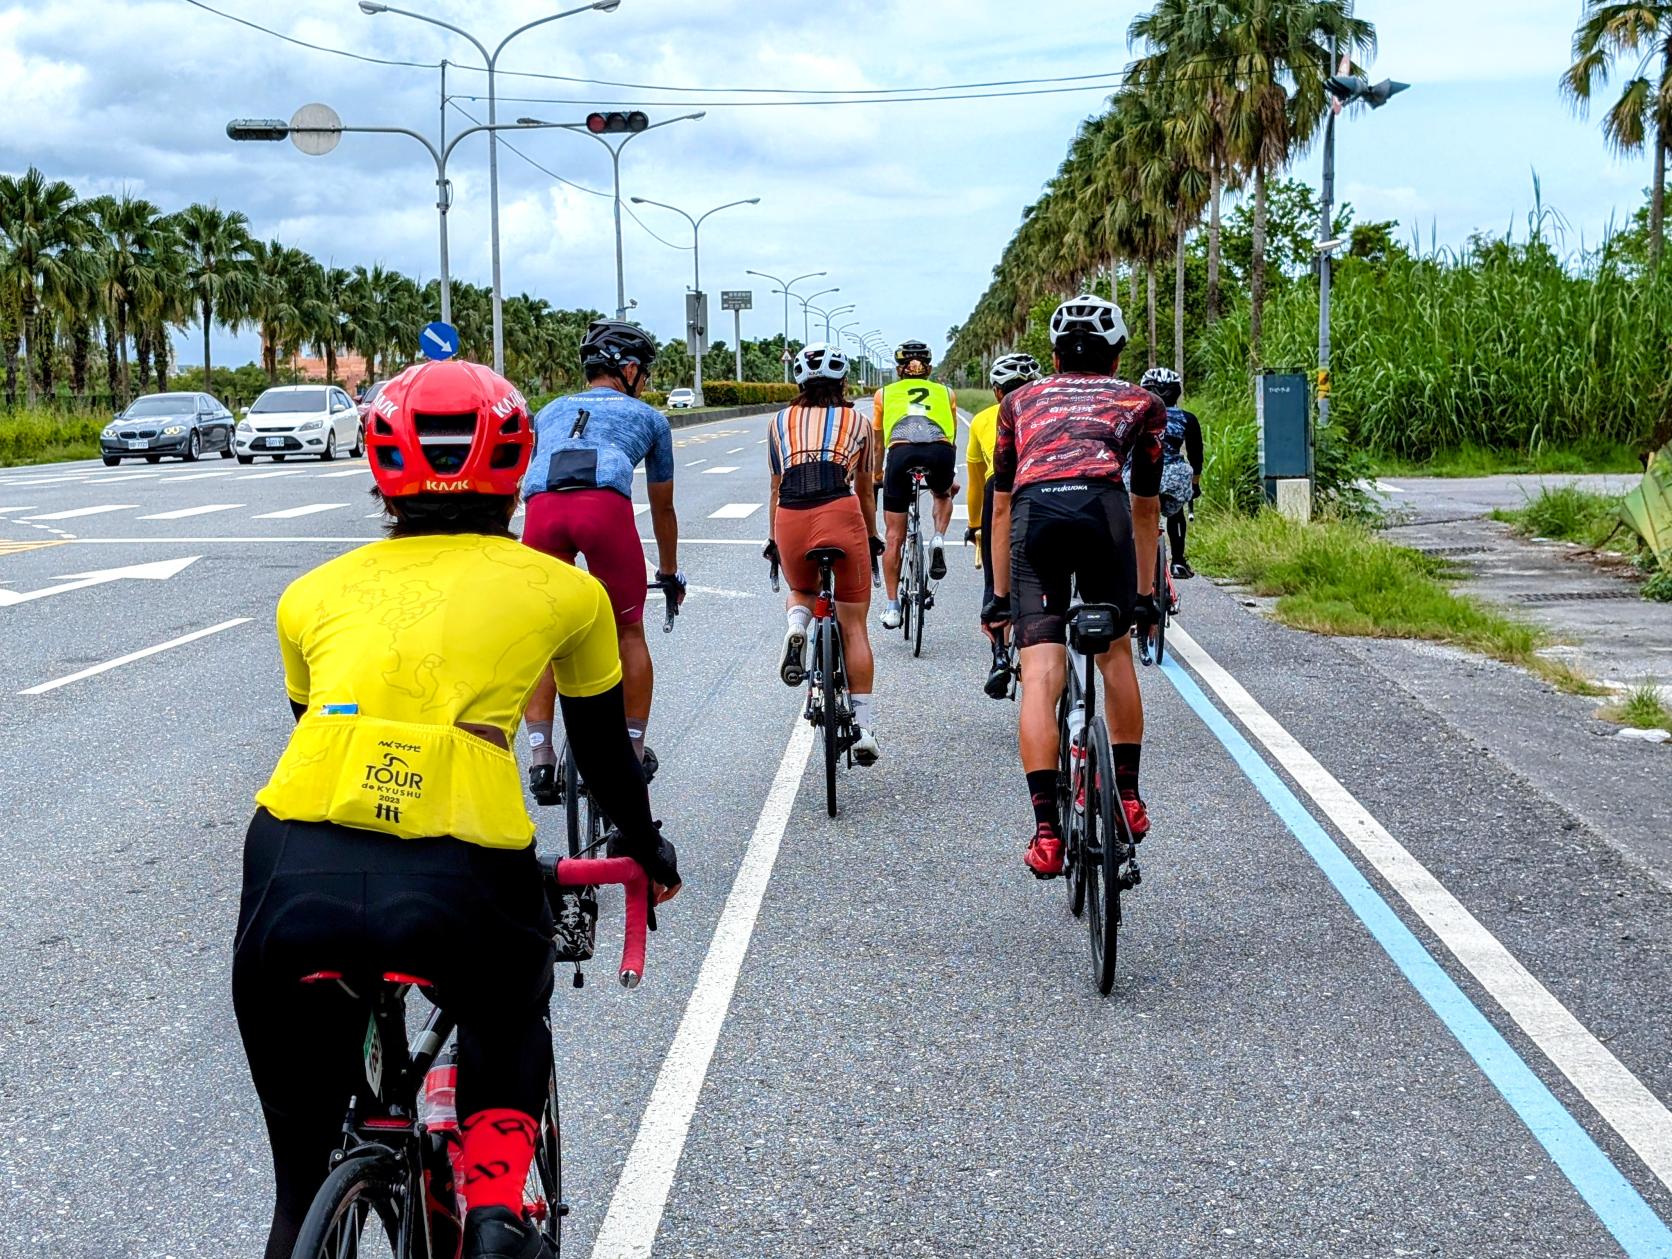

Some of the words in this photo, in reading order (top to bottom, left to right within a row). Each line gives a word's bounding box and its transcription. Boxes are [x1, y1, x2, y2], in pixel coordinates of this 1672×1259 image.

[908, 388, 931, 410] 2
[425, 479, 469, 490] KASK
[366, 765, 423, 790] TOUR
[376, 785, 421, 799] KYUSHU
[379, 794, 400, 804] 2023
